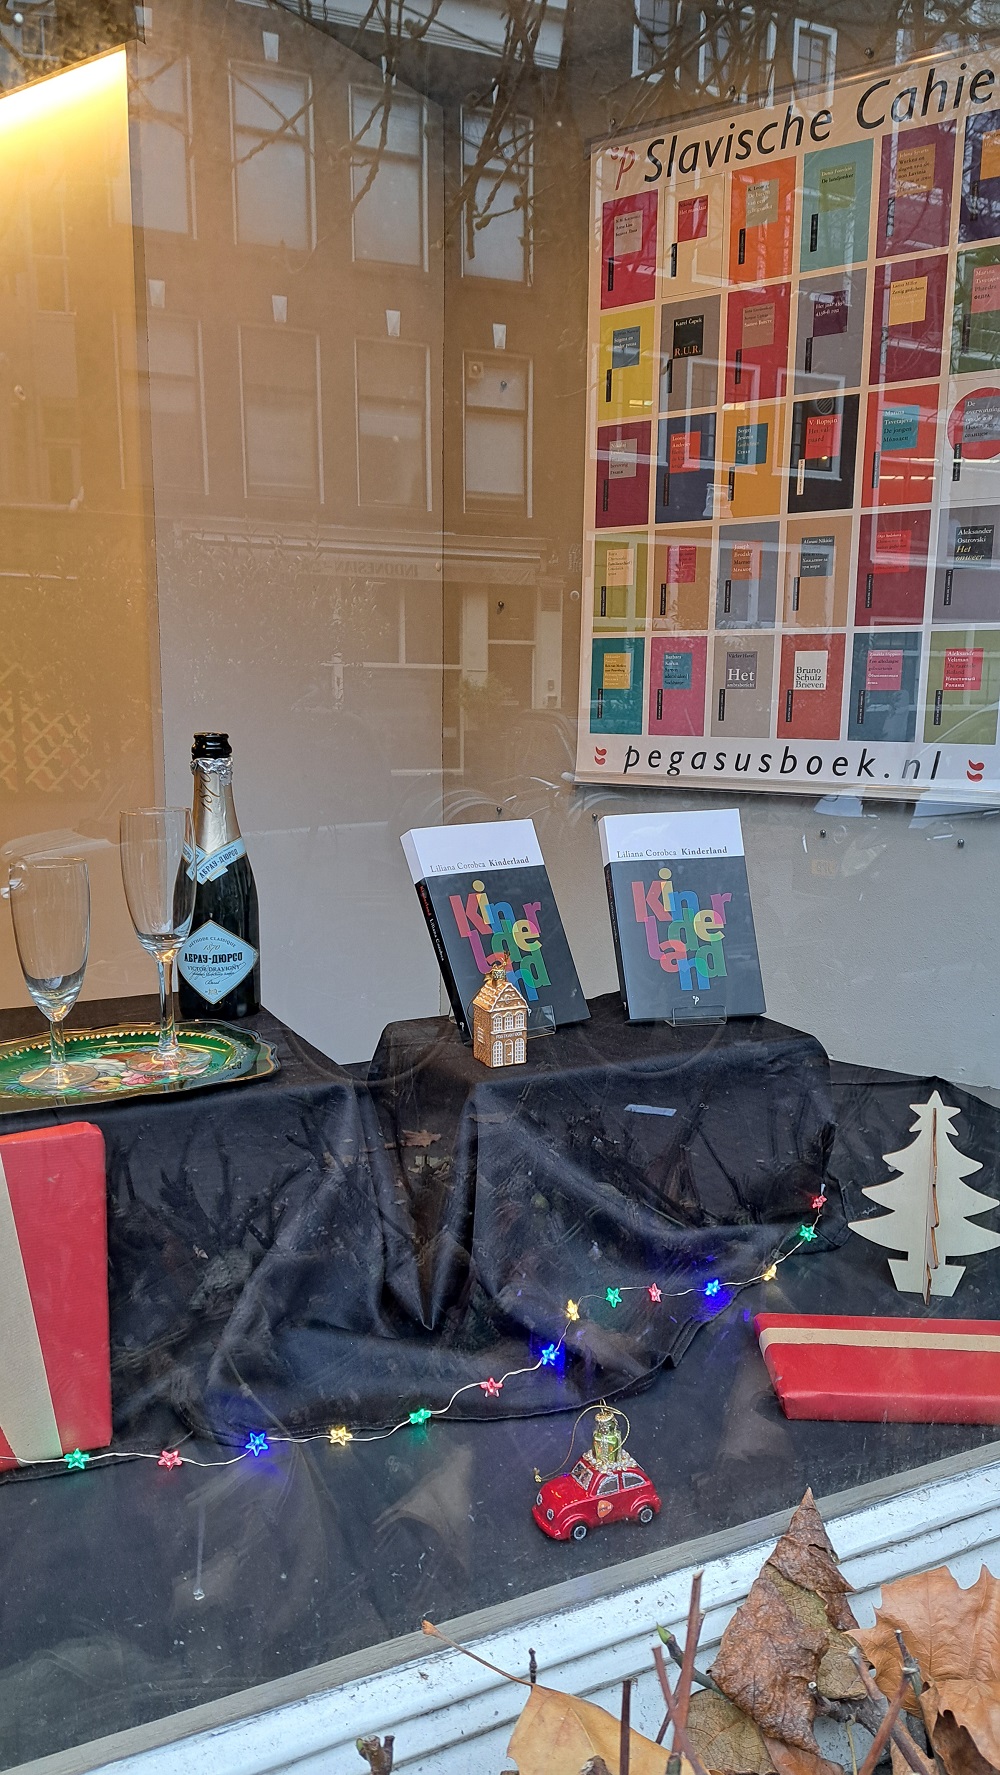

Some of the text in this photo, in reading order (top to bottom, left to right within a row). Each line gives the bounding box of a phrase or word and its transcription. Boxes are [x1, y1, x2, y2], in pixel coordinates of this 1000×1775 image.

[645, 105, 833, 182] Slavische
[688, 317, 703, 325] Čapek
[674, 345, 701, 356] R.U.R.
[816, 418, 838, 426] Ropsjin
[884, 418, 913, 426] Tsvetajeva
[956, 545, 972, 553] Het
[728, 668, 755, 681] Het
[796, 666, 822, 674] Bruno
[796, 673, 822, 681] Schulz
[795, 680, 825, 688] Brieven
[622, 745, 942, 781] pegasusboek.nl
[617, 846, 728, 859] Liliana Corobca Kinderland
[198, 847, 239, 879] АБРАУ-ДЮРСО
[430, 856, 530, 873] Liliana Corobca Kinderland
[209, 936, 237, 948] CLASSIQUE
[203, 943, 221, 953] 1870
[184, 951, 243, 964] АБРАУ-ДЮРСО
[208, 963, 241, 972] DRAVIGNY
